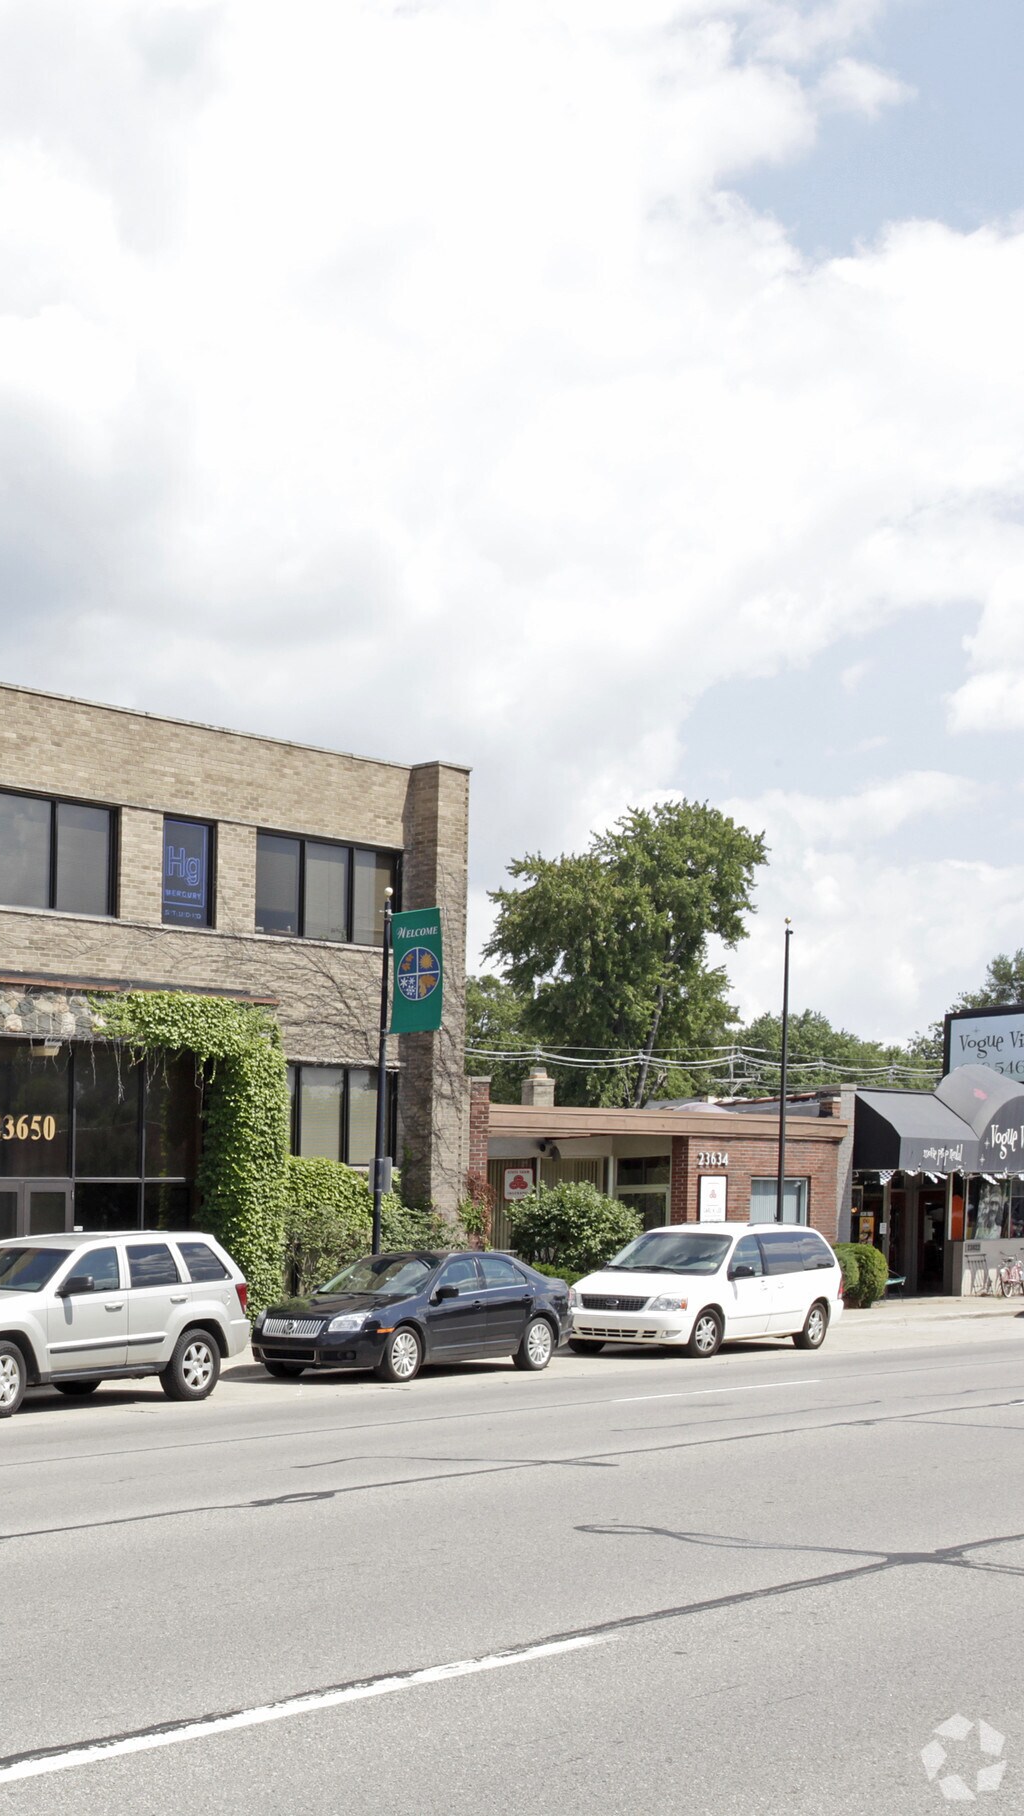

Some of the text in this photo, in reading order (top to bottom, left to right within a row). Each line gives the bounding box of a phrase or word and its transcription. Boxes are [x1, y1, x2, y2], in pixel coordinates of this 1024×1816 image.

[168, 845, 201, 887] Hg
[165, 889, 202, 900] MERCURY
[396, 926, 439, 939] WELCOME
[959, 1034, 1004, 1059] Vogue
[991, 1124, 1018, 1160] Vogue
[698, 1152, 729, 1166] 23634
